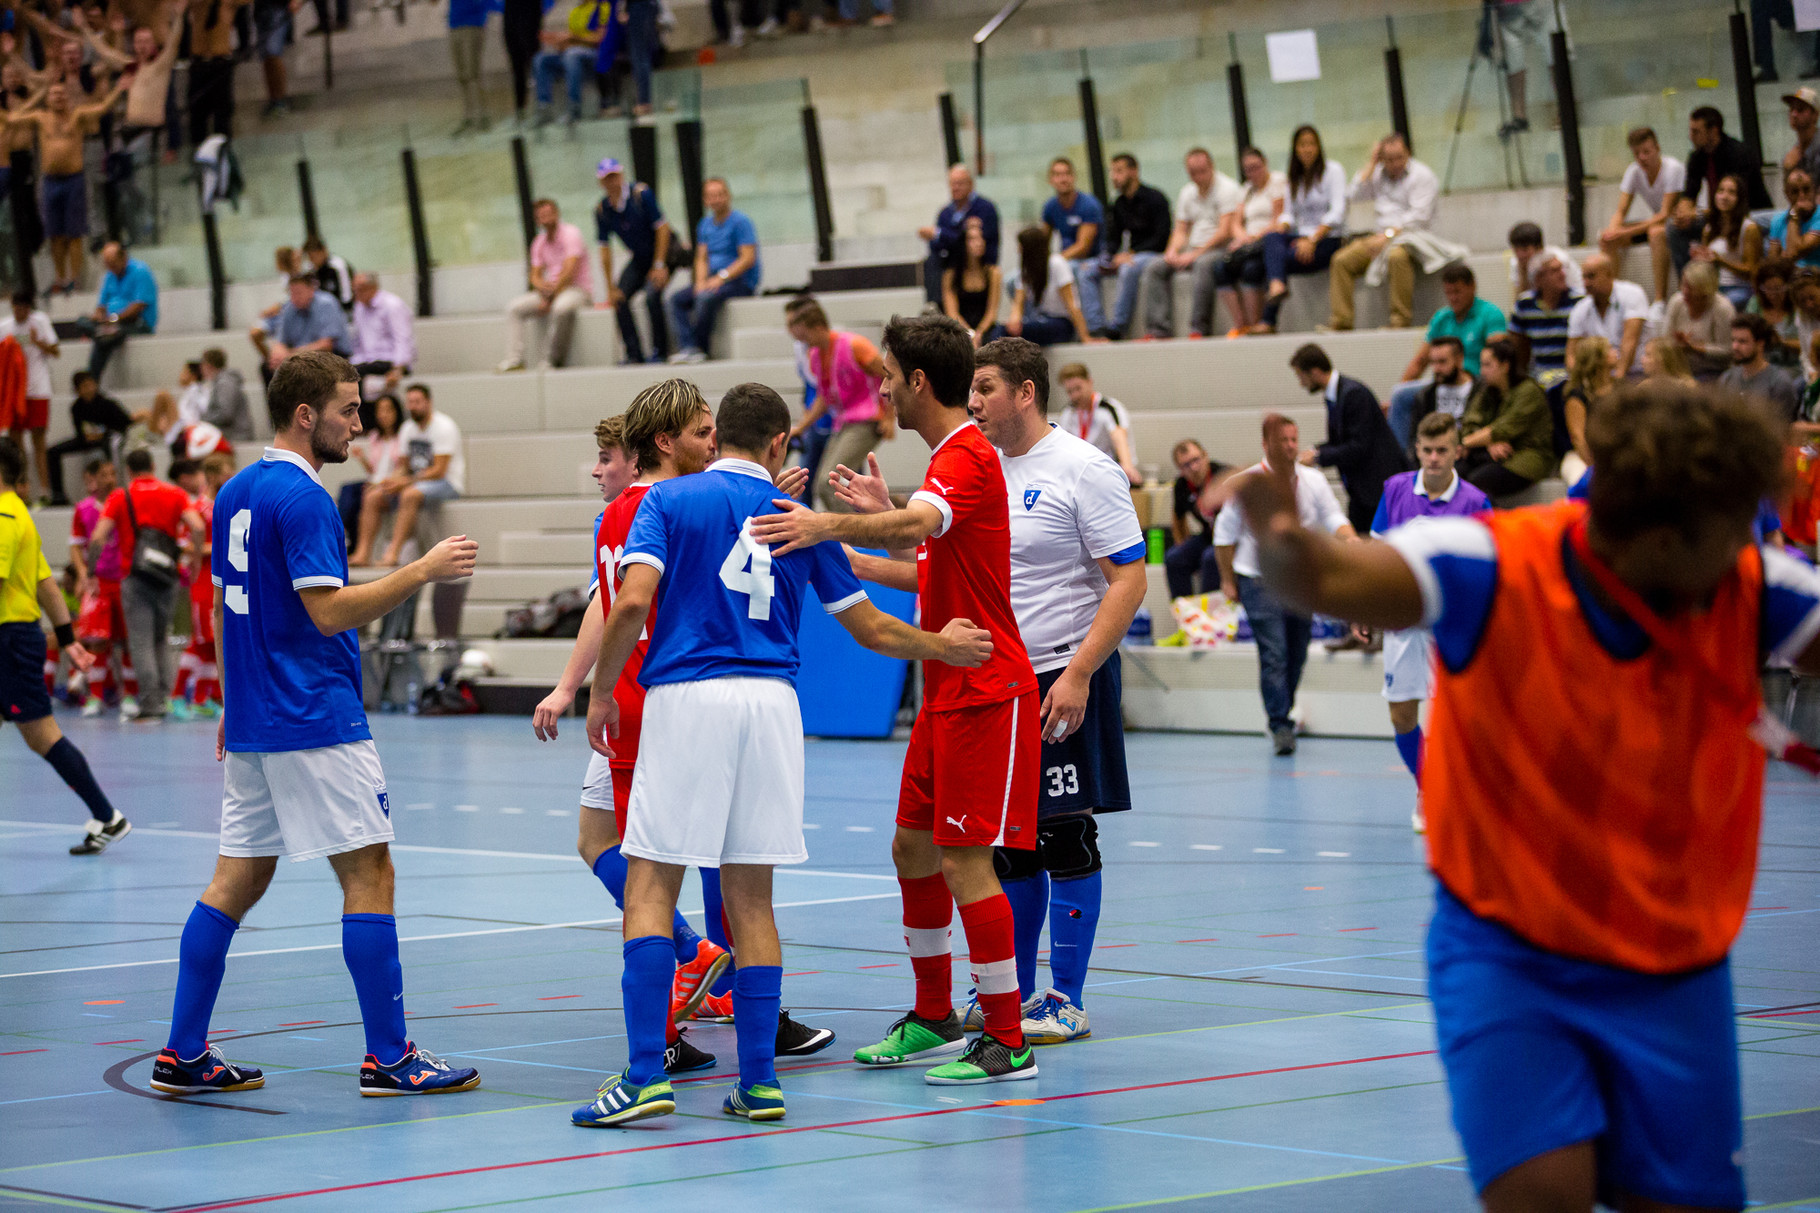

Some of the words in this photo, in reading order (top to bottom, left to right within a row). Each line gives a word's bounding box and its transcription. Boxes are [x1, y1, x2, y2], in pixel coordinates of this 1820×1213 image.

[1025, 491, 1035, 505] d
[719, 515, 775, 621] 4
[1046, 764, 1079, 797] 33
